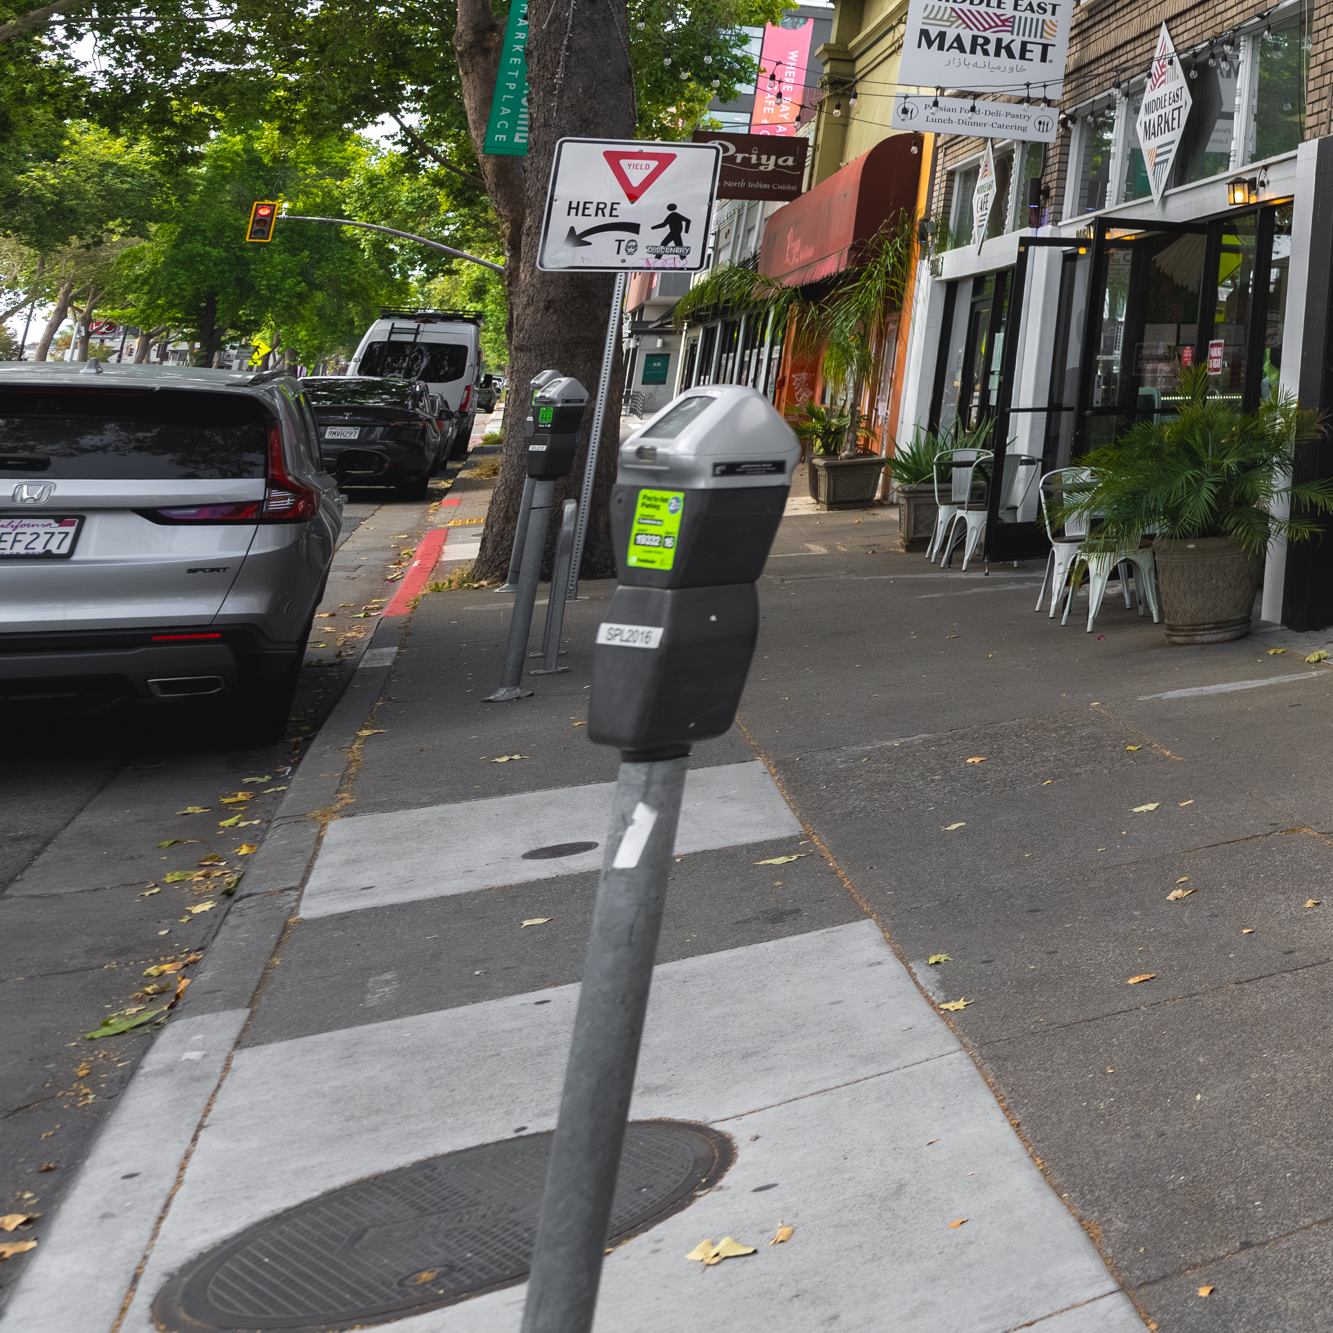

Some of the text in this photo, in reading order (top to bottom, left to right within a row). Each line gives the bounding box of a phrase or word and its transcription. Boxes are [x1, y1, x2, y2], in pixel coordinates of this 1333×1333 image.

[917, 28, 1056, 64] MARKET
[782, 50, 799, 92] WHERE
[1144, 86, 1184, 118] MIDDLE EAST
[924, 103, 1033, 122] Psian Fod-Deli-Pastry
[925, 115, 1028, 133] Lunch-Dinner-Catering
[1143, 104, 1183, 143] MARKET
[708, 140, 796, 171] Priya
[627, 163, 650, 171] YIELD
[724, 179, 797, 191] North Indian Cuisine
[567, 200, 621, 218] HERE
[976, 193, 990, 214] CAFE
[0, 519, 53, 532] alifornia
[186, 566, 231, 574] SPORT
